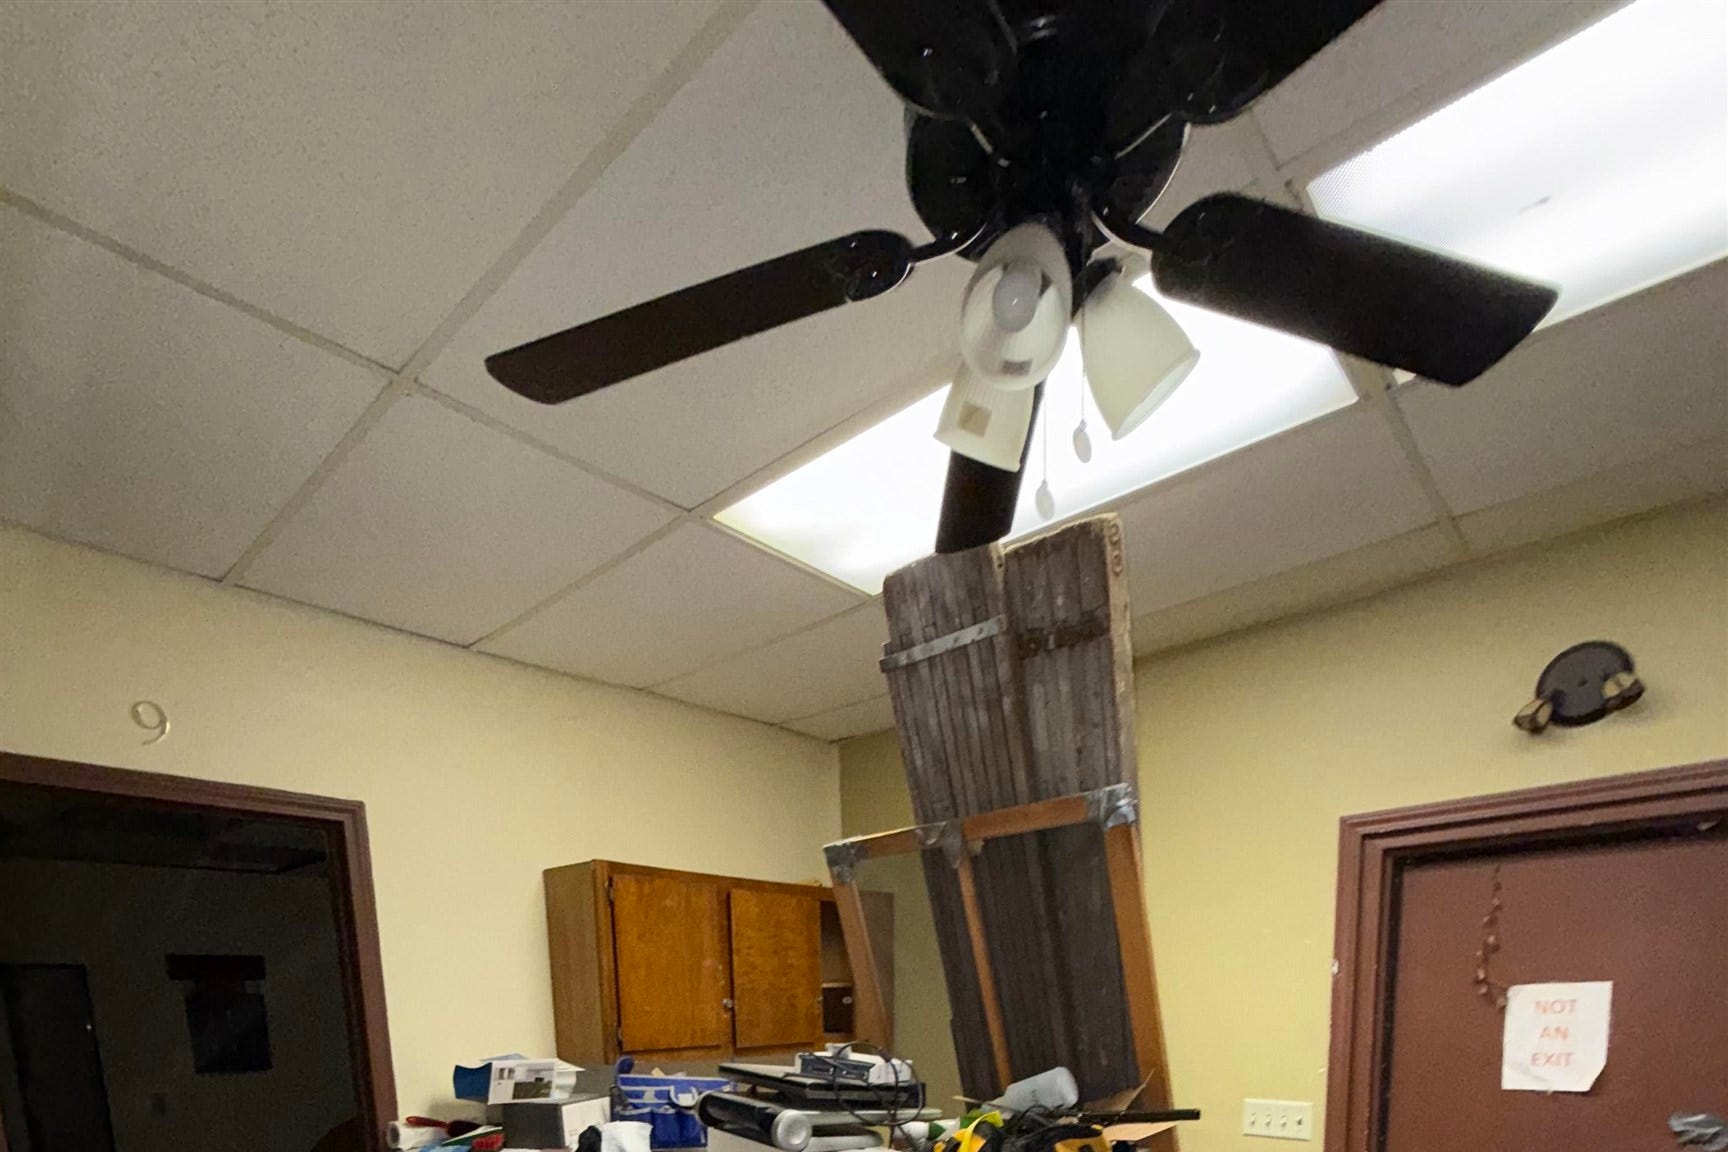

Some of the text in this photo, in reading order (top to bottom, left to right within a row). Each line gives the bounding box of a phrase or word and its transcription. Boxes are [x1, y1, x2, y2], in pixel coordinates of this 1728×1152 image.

[130, 700, 171, 746] 9
[1535, 999, 1577, 1014] NOT
[1539, 1026, 1569, 1041] AN
[1530, 1052, 1574, 1067] EXIT
